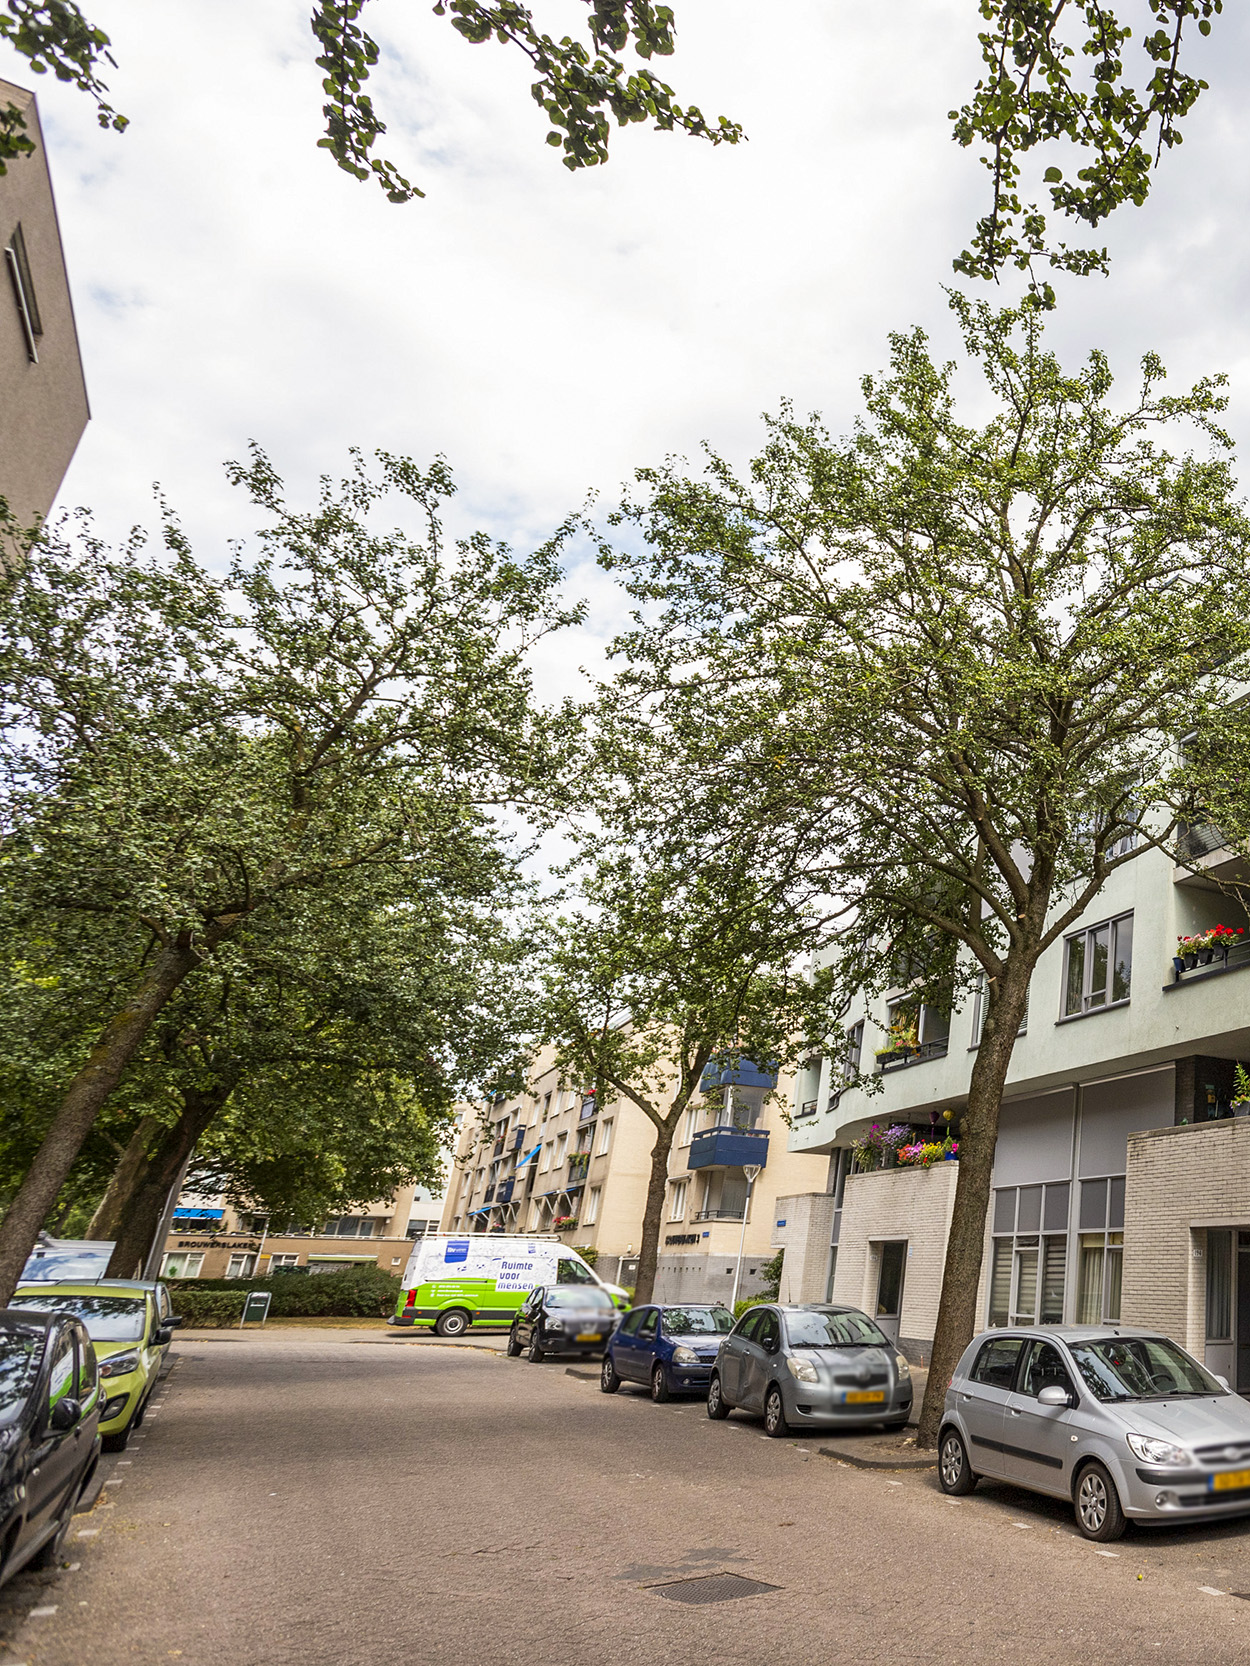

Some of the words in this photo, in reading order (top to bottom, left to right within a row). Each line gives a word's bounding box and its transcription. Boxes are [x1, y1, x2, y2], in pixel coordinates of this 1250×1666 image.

[501, 1261, 533, 1270] Ruimte
[500, 1272, 520, 1280] voor
[497, 1282, 534, 1290] mensen
